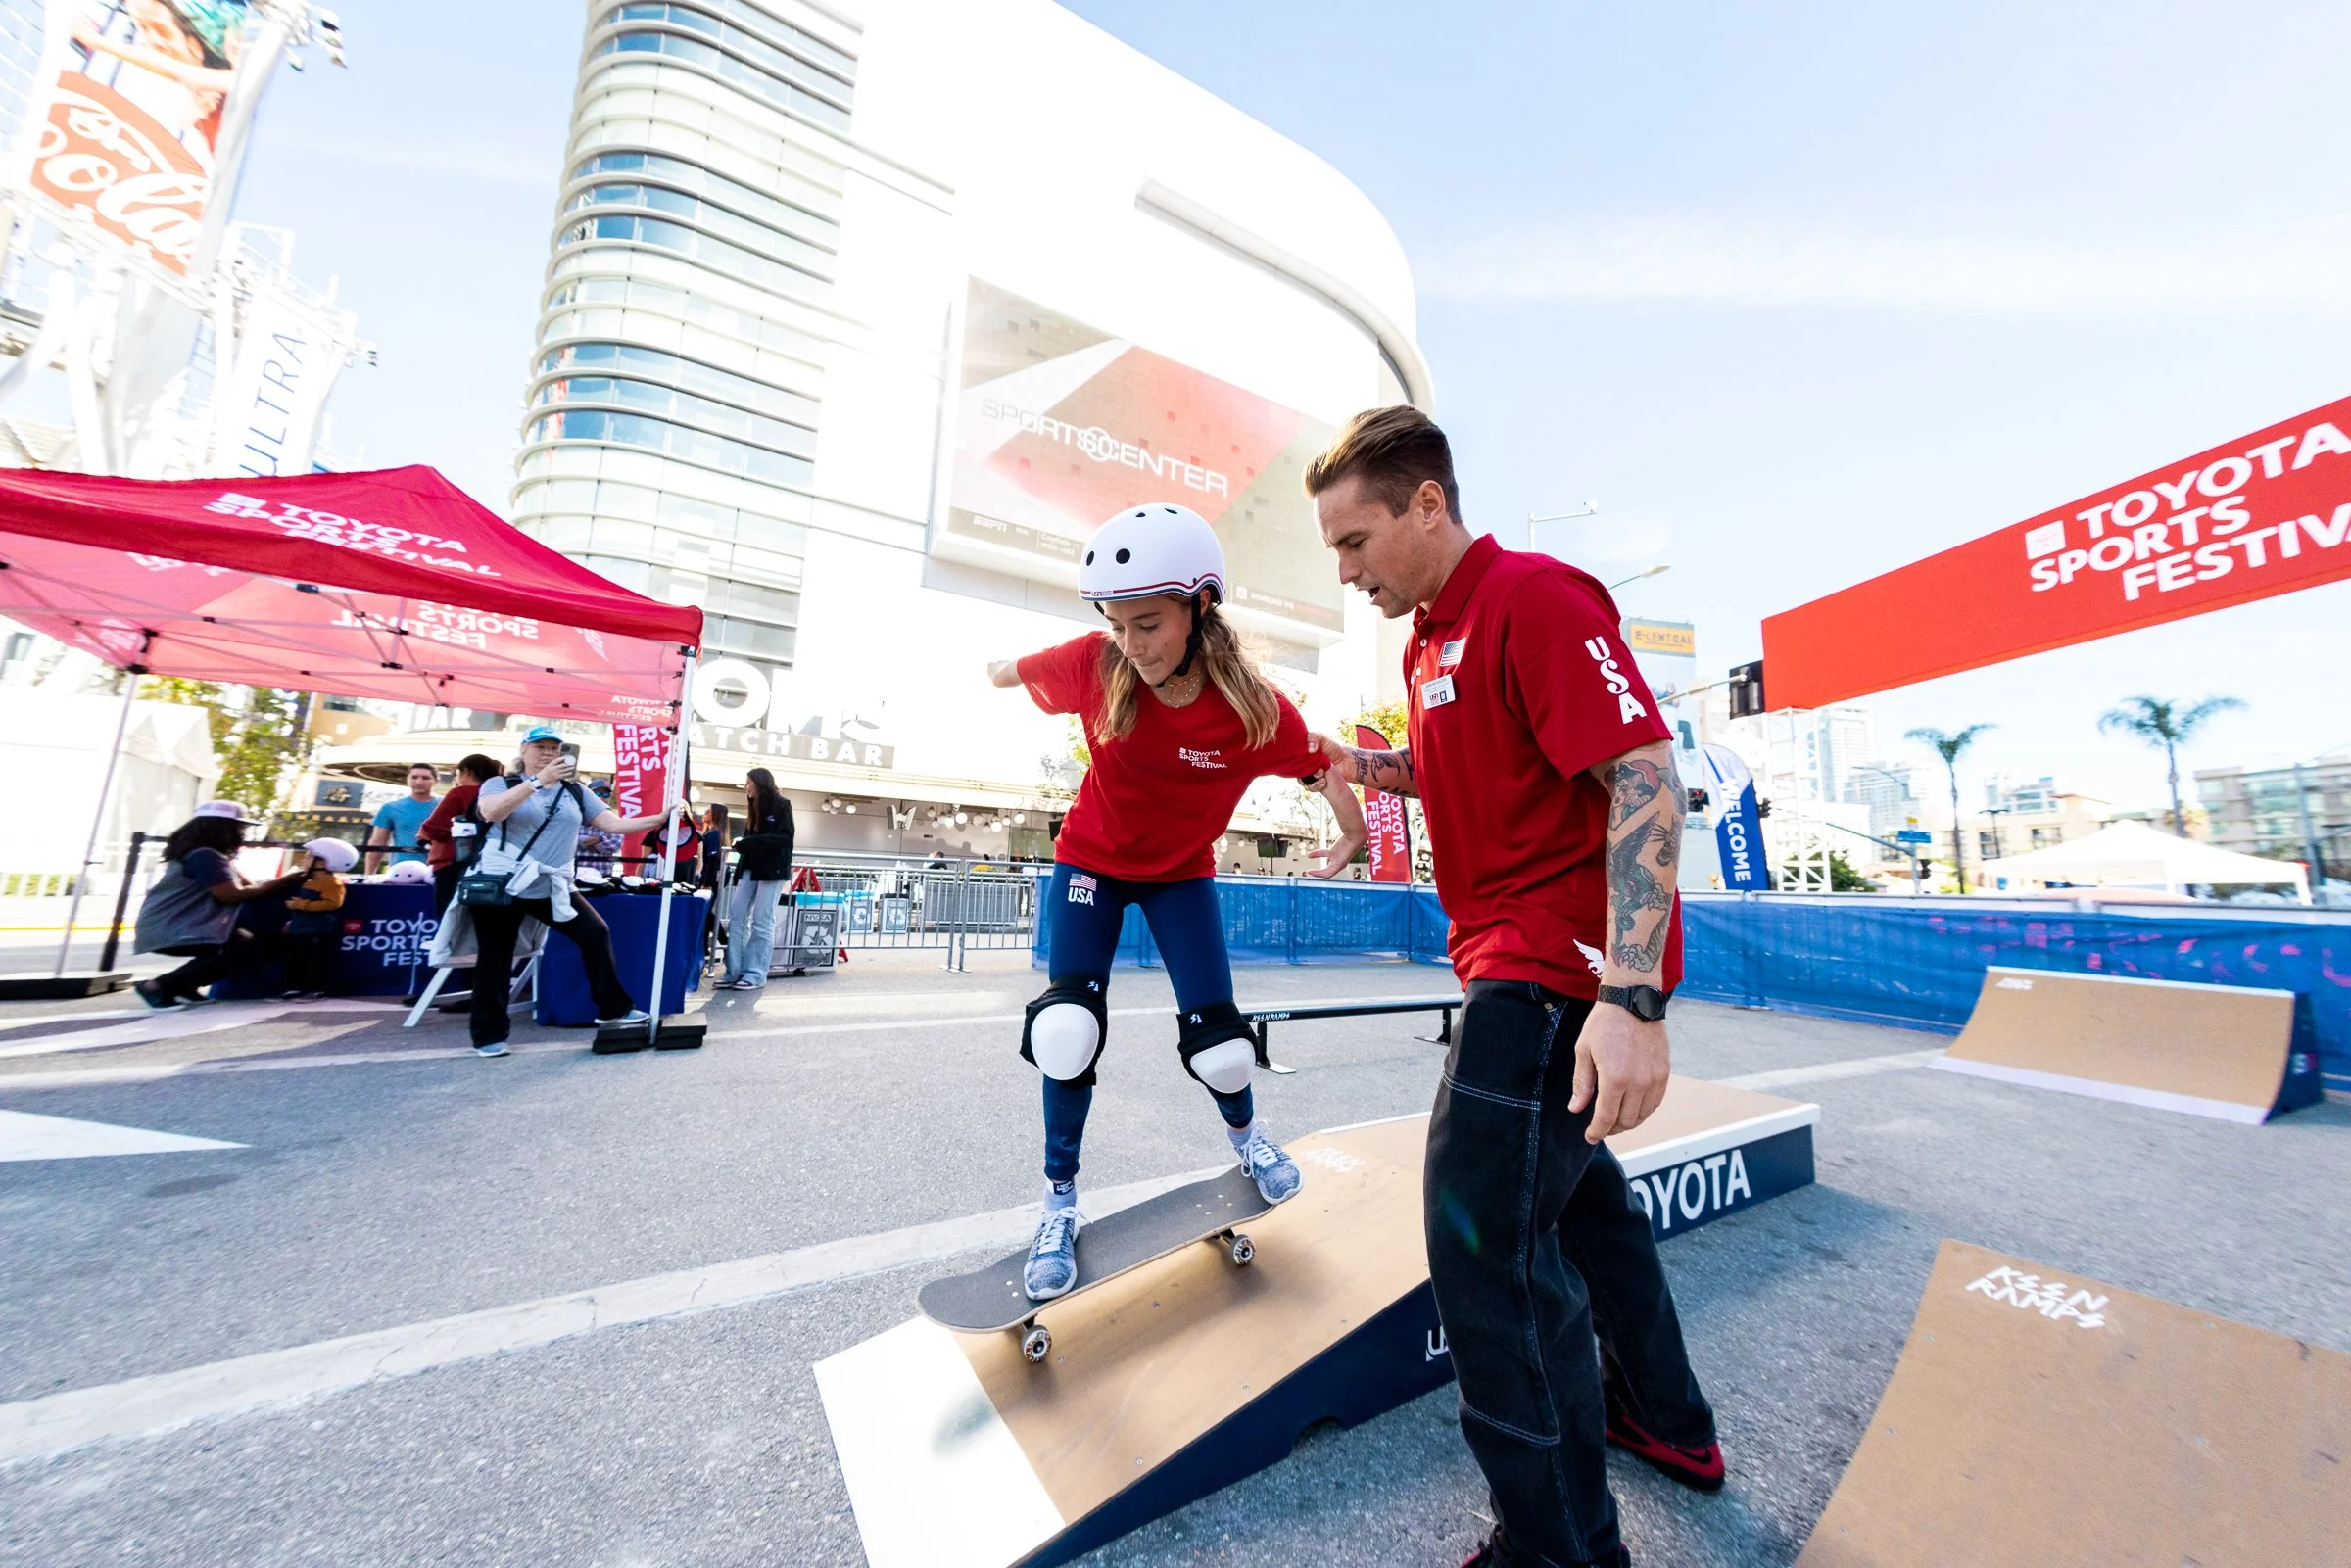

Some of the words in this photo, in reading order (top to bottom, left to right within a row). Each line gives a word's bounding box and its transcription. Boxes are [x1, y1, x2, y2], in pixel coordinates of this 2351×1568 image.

[239, 333, 307, 477] ULTRA
[2076, 422, 2351, 539] TOYOTA
[203, 501, 401, 548] SPORTS
[279, 503, 468, 552] TOYOTA
[2030, 496, 2251, 592] SPORTS
[2122, 502, 2351, 601] FESTIV
[1584, 635, 1648, 725] USA
[639, 727, 661, 772] RTS
[689, 722, 792, 756] ATCH
[810, 737, 883, 766] BAR
[1179, 753, 1209, 762] SPORTS
[615, 724, 644, 820] FESTIVA
[1378, 792, 1392, 833] ORTS
[1390, 795, 1406, 855] OYOTA
[1367, 801, 1383, 876] FESTIVAL
[1068, 886, 1095, 907] USA
[369, 919, 439, 934] TOYO
[383, 951, 432, 967] FEST
[1630, 1149, 1752, 1229] OYOTA
[1985, 1265, 2110, 1311] KEEN
